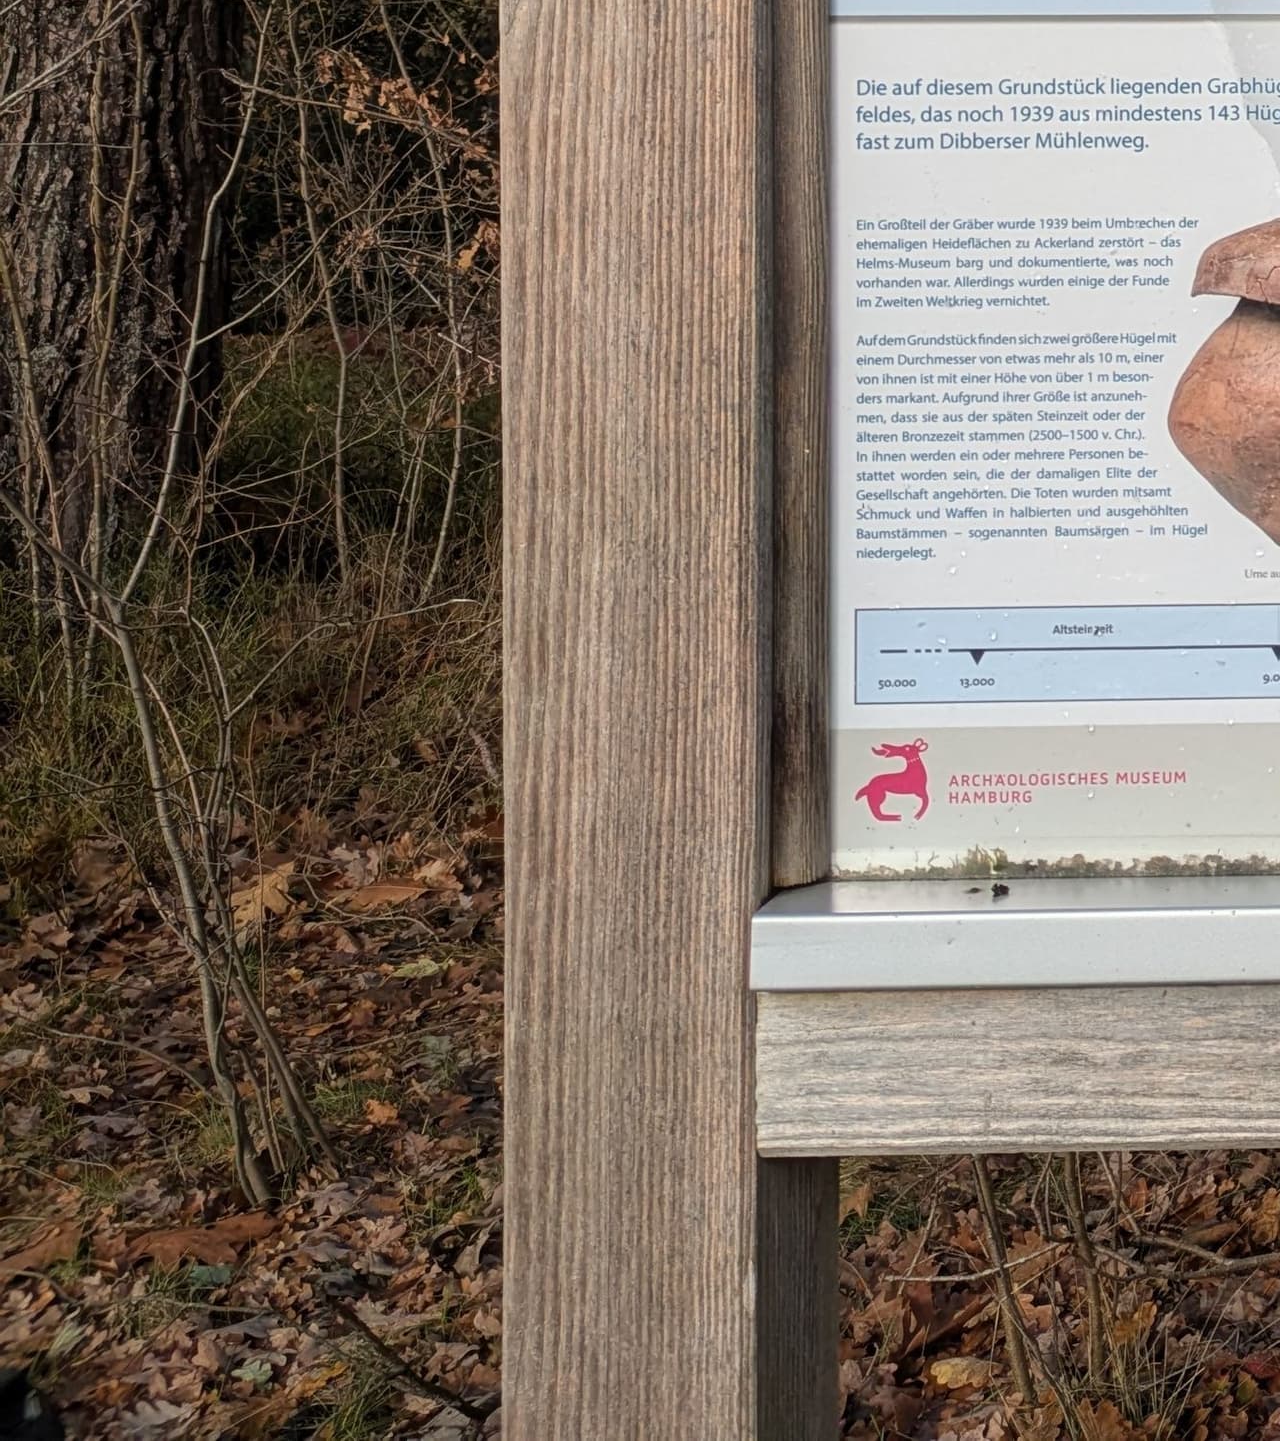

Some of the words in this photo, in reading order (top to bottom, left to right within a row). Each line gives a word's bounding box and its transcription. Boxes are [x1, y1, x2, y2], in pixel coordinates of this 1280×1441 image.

[856, 79, 887, 96] Die
[892, 78, 922, 95] auf
[926, 77, 992, 95] diesem
[998, 77, 1106, 95] Grundstück
[1110, 77, 1202, 99] liegenden
[855, 105, 915, 125] feldes,
[920, 104, 952, 122] das
[958, 104, 1003, 122] noch
[1010, 105, 1054, 122] 1939
[1058, 109, 1090, 122] aus
[1095, 103, 1202, 121] mindestens
[1208, 104, 1240, 121] 143
[855, 132, 890, 150] fast
[894, 137, 934, 149] zum
[940, 131, 1030, 149] Dibberser
[1035, 131, 1149, 152] Mühlenweg.
[856, 219, 874, 230] Ein
[877, 218, 926, 230] Großteil
[929, 218, 950, 230] der
[952, 218, 994, 230] Gräber
[996, 217, 1036, 229] wurde
[1039, 218, 1068, 229] 1939
[1071, 217, 1102, 229] beim
[1178, 216, 1198, 228] der
[856, 237, 927, 252] ehemaligen
[932, 237, 1011, 249] Heideflächen
[1015, 239, 1030, 248] zu
[1034, 236, 1094, 248] Ackerland
[1098, 237, 1144, 248] zerstört
[1160, 237, 1181, 247] das
[856, 256, 950, 269] Helms-Museum
[956, 256, 984, 271] barg
[988, 256, 1012, 268] und
[1017, 255, 1110, 268] dokumentierte,
[1114, 258, 1138, 267] was
[1143, 255, 1173, 267] noch
[856, 276, 922, 288] vorhanden
[925, 279, 950, 288] war.
[953, 275, 1014, 290] Allerdings
[1018, 275, 1064, 287] wurden
[1067, 275, 1105, 289] einige
[1108, 274, 1128, 286] der
[1132, 274, 1170, 286] Funde
[856, 296, 872, 308] im
[874, 296, 923, 308] Zweiten
[985, 294, 1050, 306] vernichtet.
[1244, 568, 1268, 578] Urne
[1052, 623, 1113, 636] Altsteinzeit
[878, 678, 916, 690] 50.000
[959, 677, 995, 688] 13.000
[948, 772, 1108, 786] ARCHÄOLOGISCHES
[1116, 771, 1186, 784] MUSEUM
[948, 790, 1032, 806] HAMBURG
